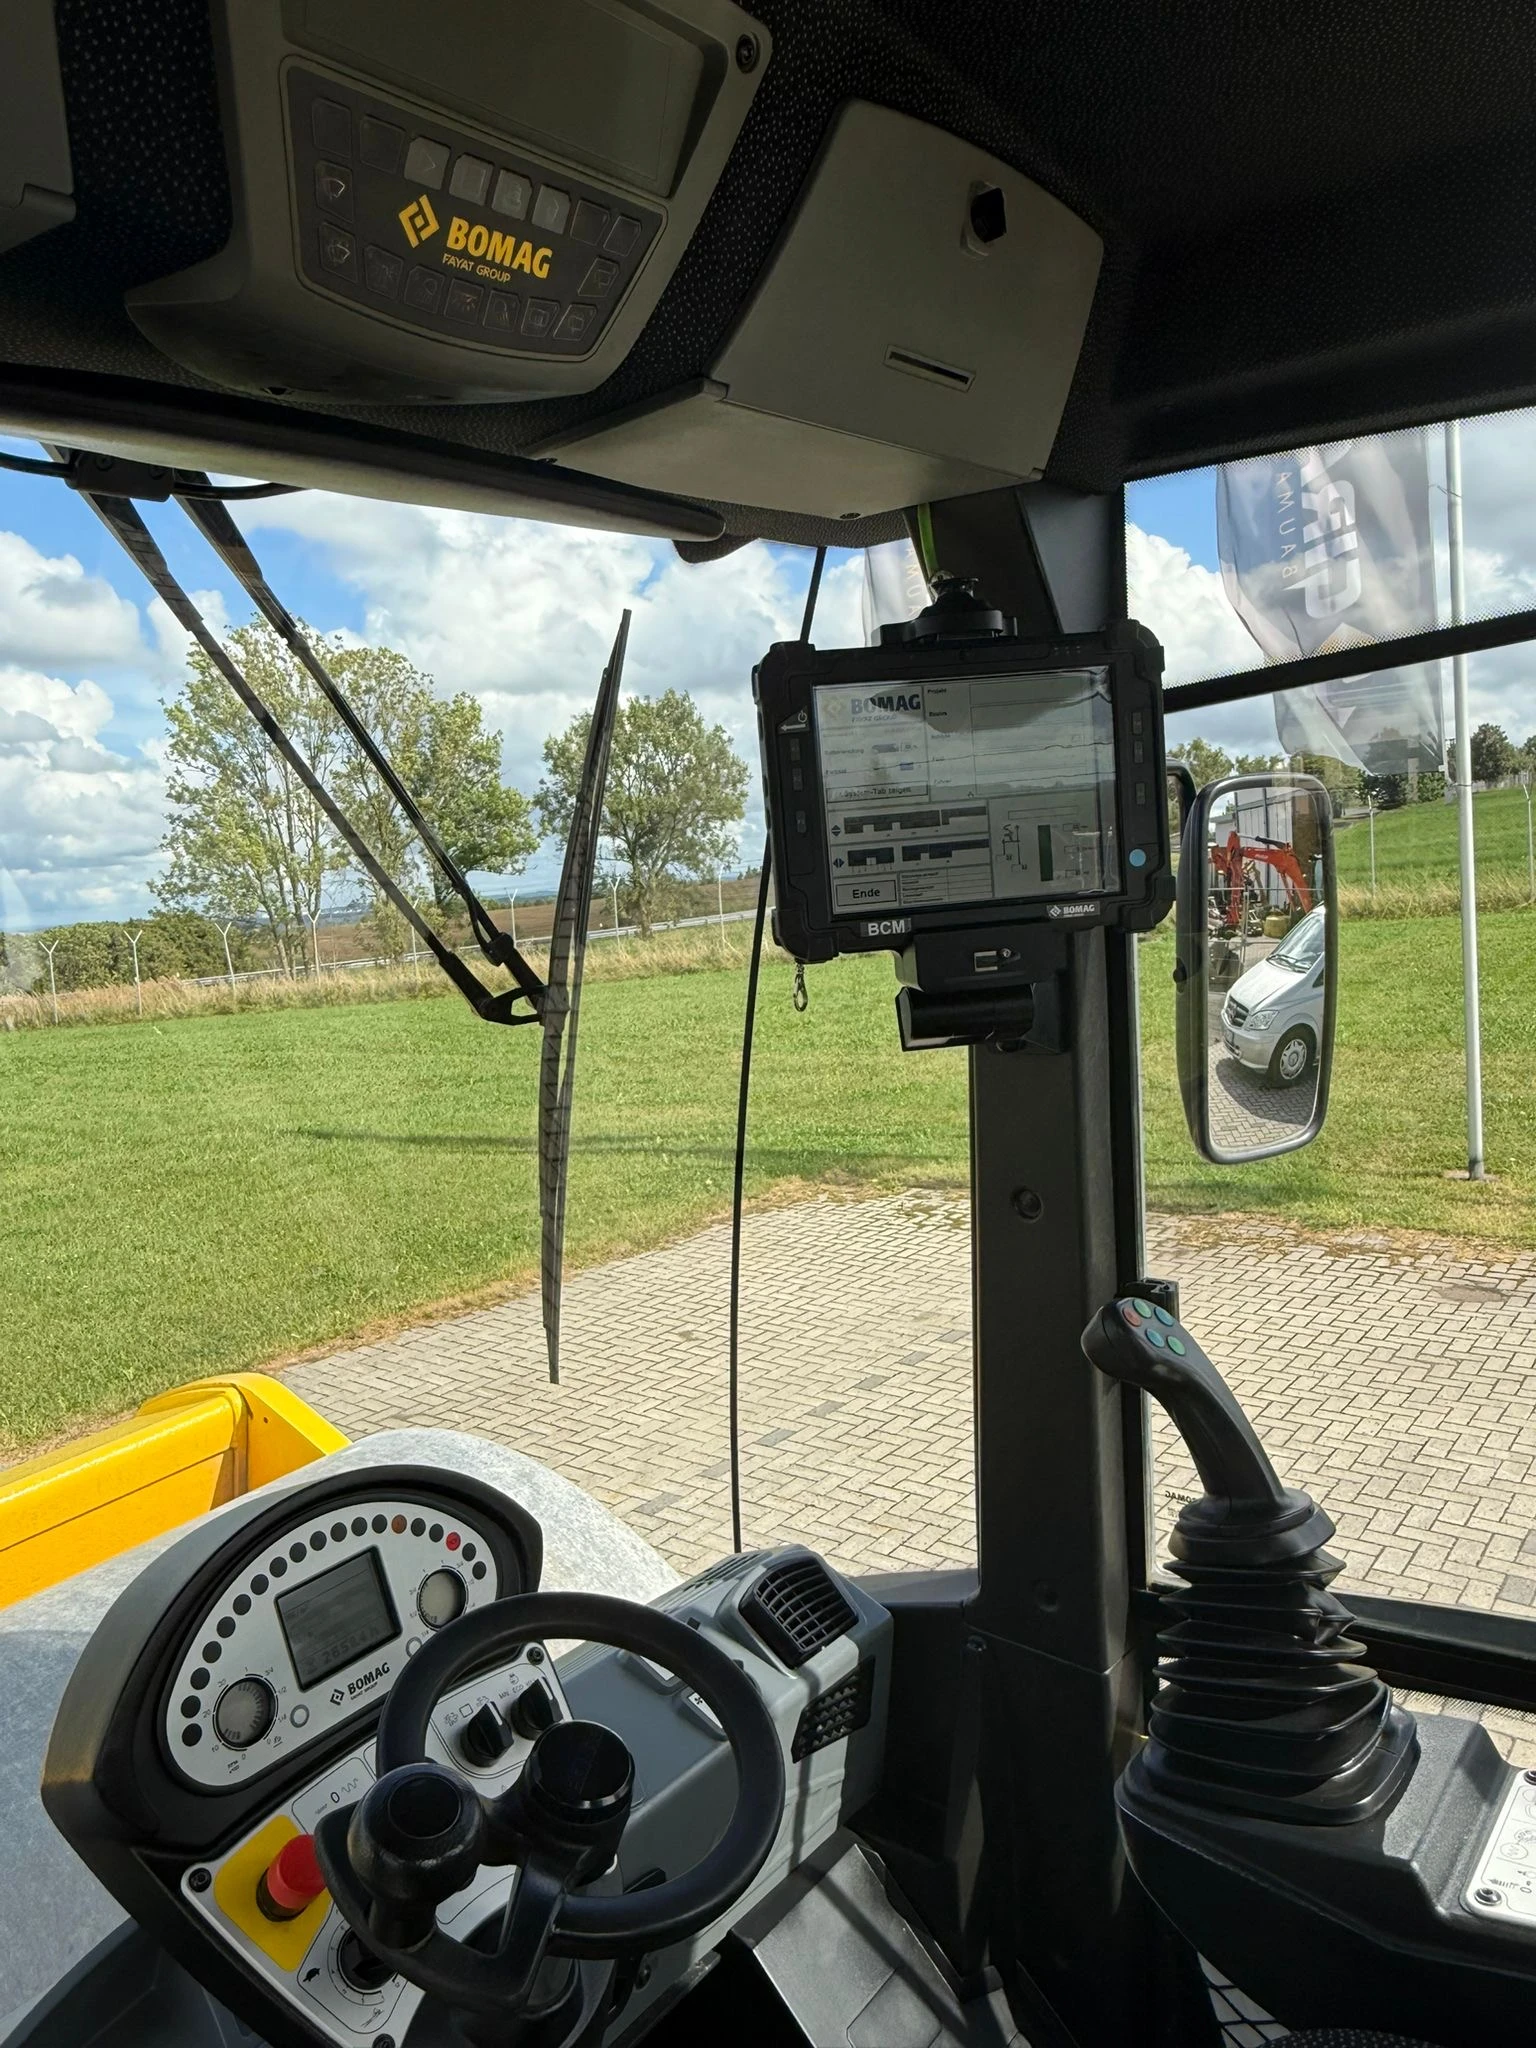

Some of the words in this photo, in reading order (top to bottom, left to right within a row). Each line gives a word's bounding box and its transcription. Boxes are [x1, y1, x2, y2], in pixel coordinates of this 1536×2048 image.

[446, 216, 553, 279] BOMAG
[442, 253, 475, 271] FAYAT
[476, 265, 511, 283] GROUP
[851, 694, 921, 715] BOMAG
[852, 888, 881, 899] Ende
[1063, 904, 1096, 914] BOMAG
[868, 920, 906, 937] BCM
[347, 1662, 391, 1695] BOMAG
